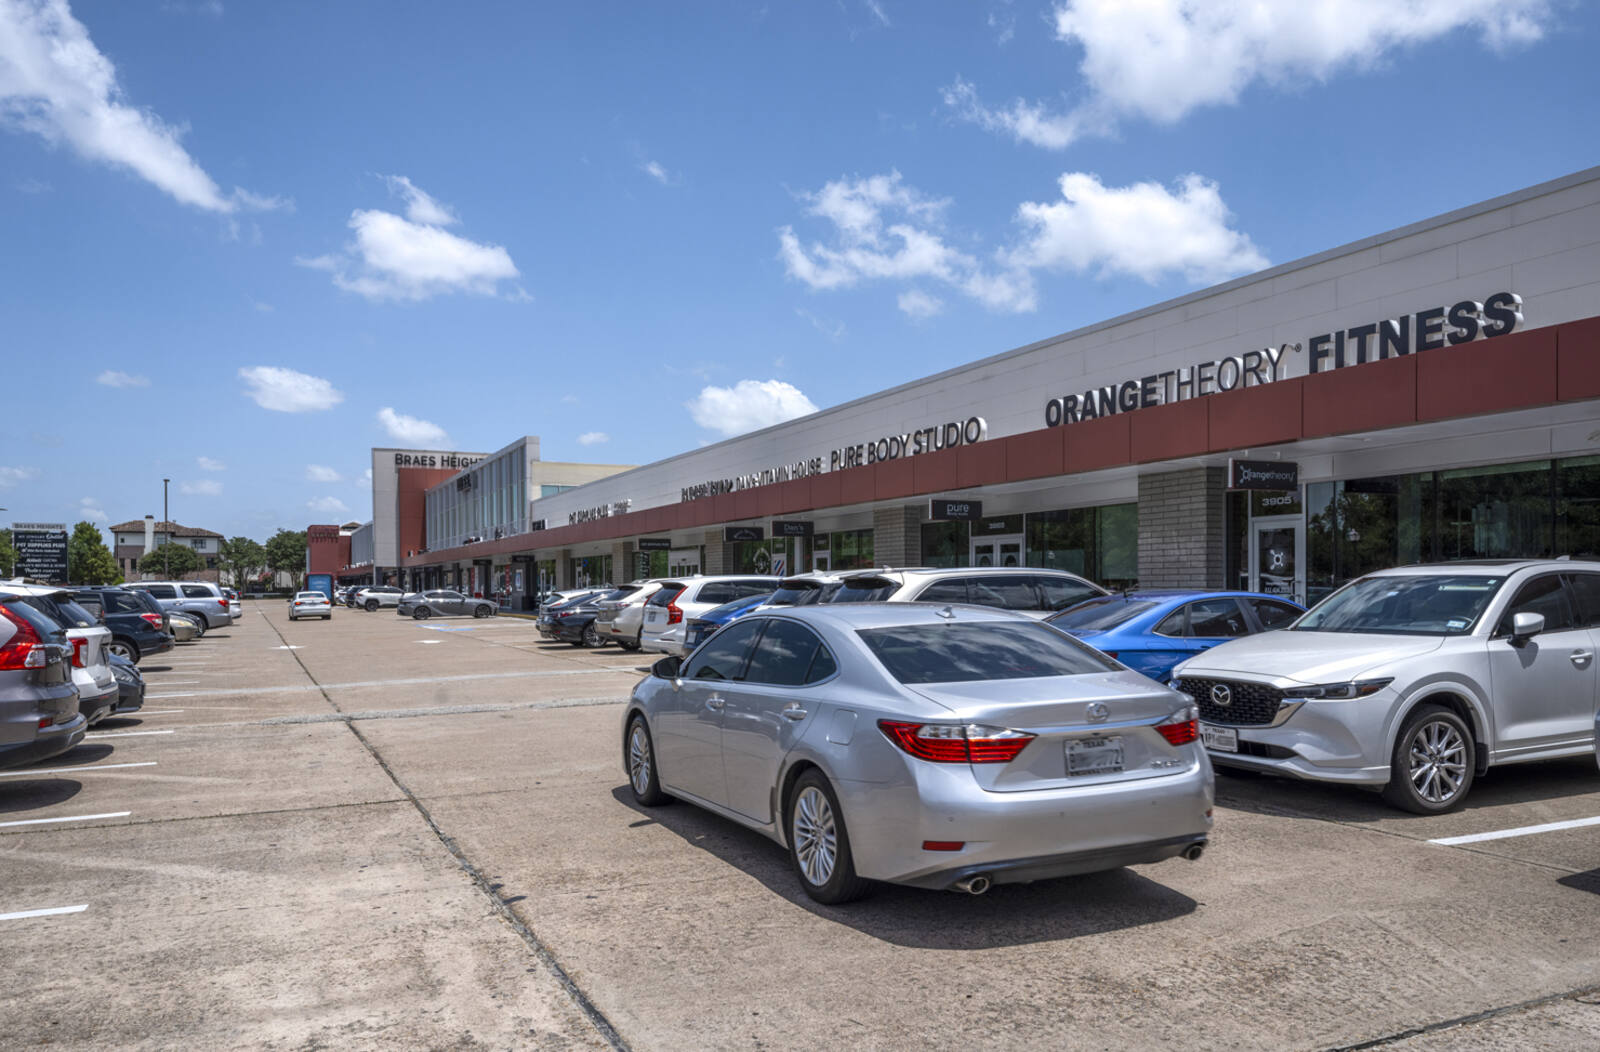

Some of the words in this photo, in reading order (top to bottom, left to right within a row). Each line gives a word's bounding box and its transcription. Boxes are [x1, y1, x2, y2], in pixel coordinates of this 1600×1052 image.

[1309, 292, 1523, 375] FITNESS
[830, 444, 864, 472] PURE
[867, 434, 911, 465] BODY
[913, 416, 983, 455] STUDIO
[394, 453, 436, 466] BRAES
[441, 456, 485, 467] HEIGH
[792, 457, 823, 480] HOUSE
[1262, 496, 1292, 506] 3905
[947, 504, 969, 513] pure
[1082, 740, 1105, 748] TEXAS
